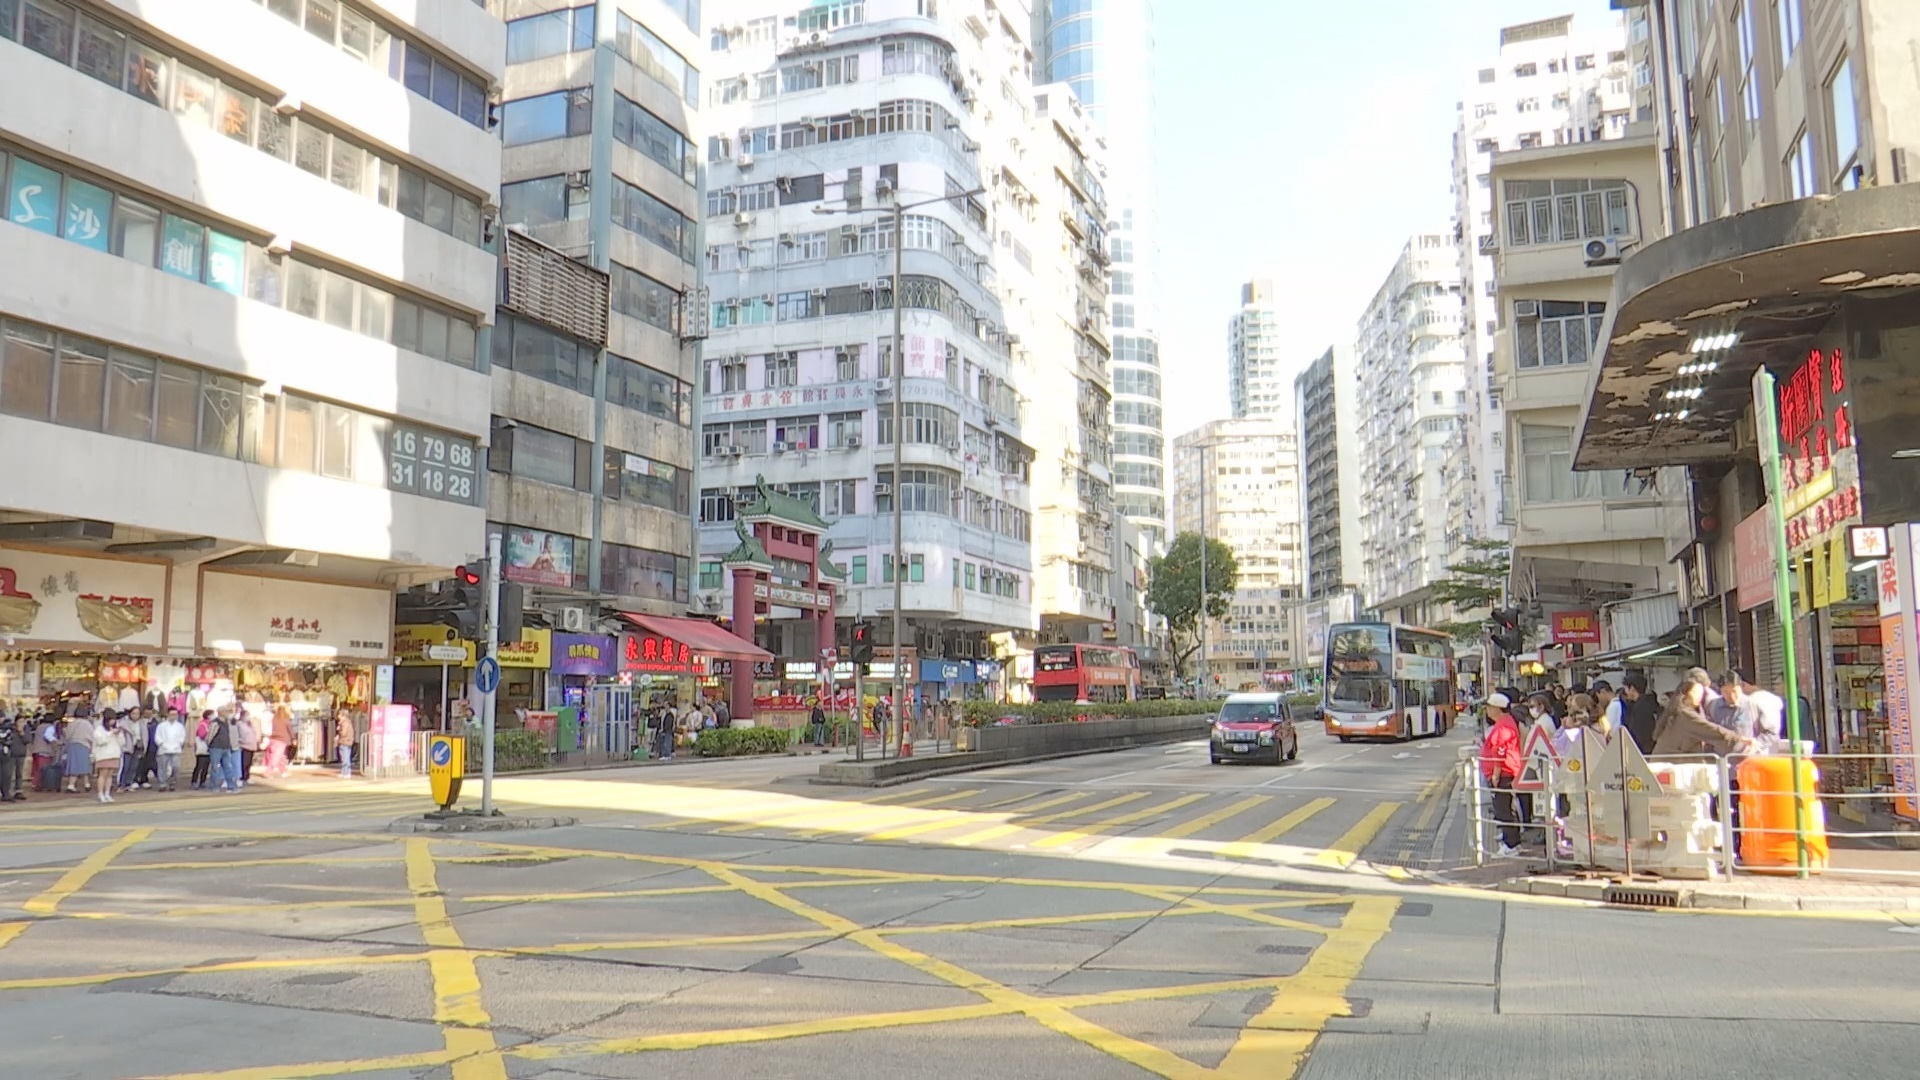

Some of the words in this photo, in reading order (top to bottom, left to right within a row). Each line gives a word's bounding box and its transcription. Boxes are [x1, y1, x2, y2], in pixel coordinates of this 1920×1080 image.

[67, 202, 101, 240] 沙
[393, 430, 416, 454] 16
[423, 436, 445, 460] 79
[450, 444, 471, 467] 68
[391, 462, 413, 487] 31
[422, 469, 444, 492] 18
[448, 475, 471, 498] 28
[270, 617, 322, 633] 地道小吃
[1561, 617, 1589, 630] 惠康
